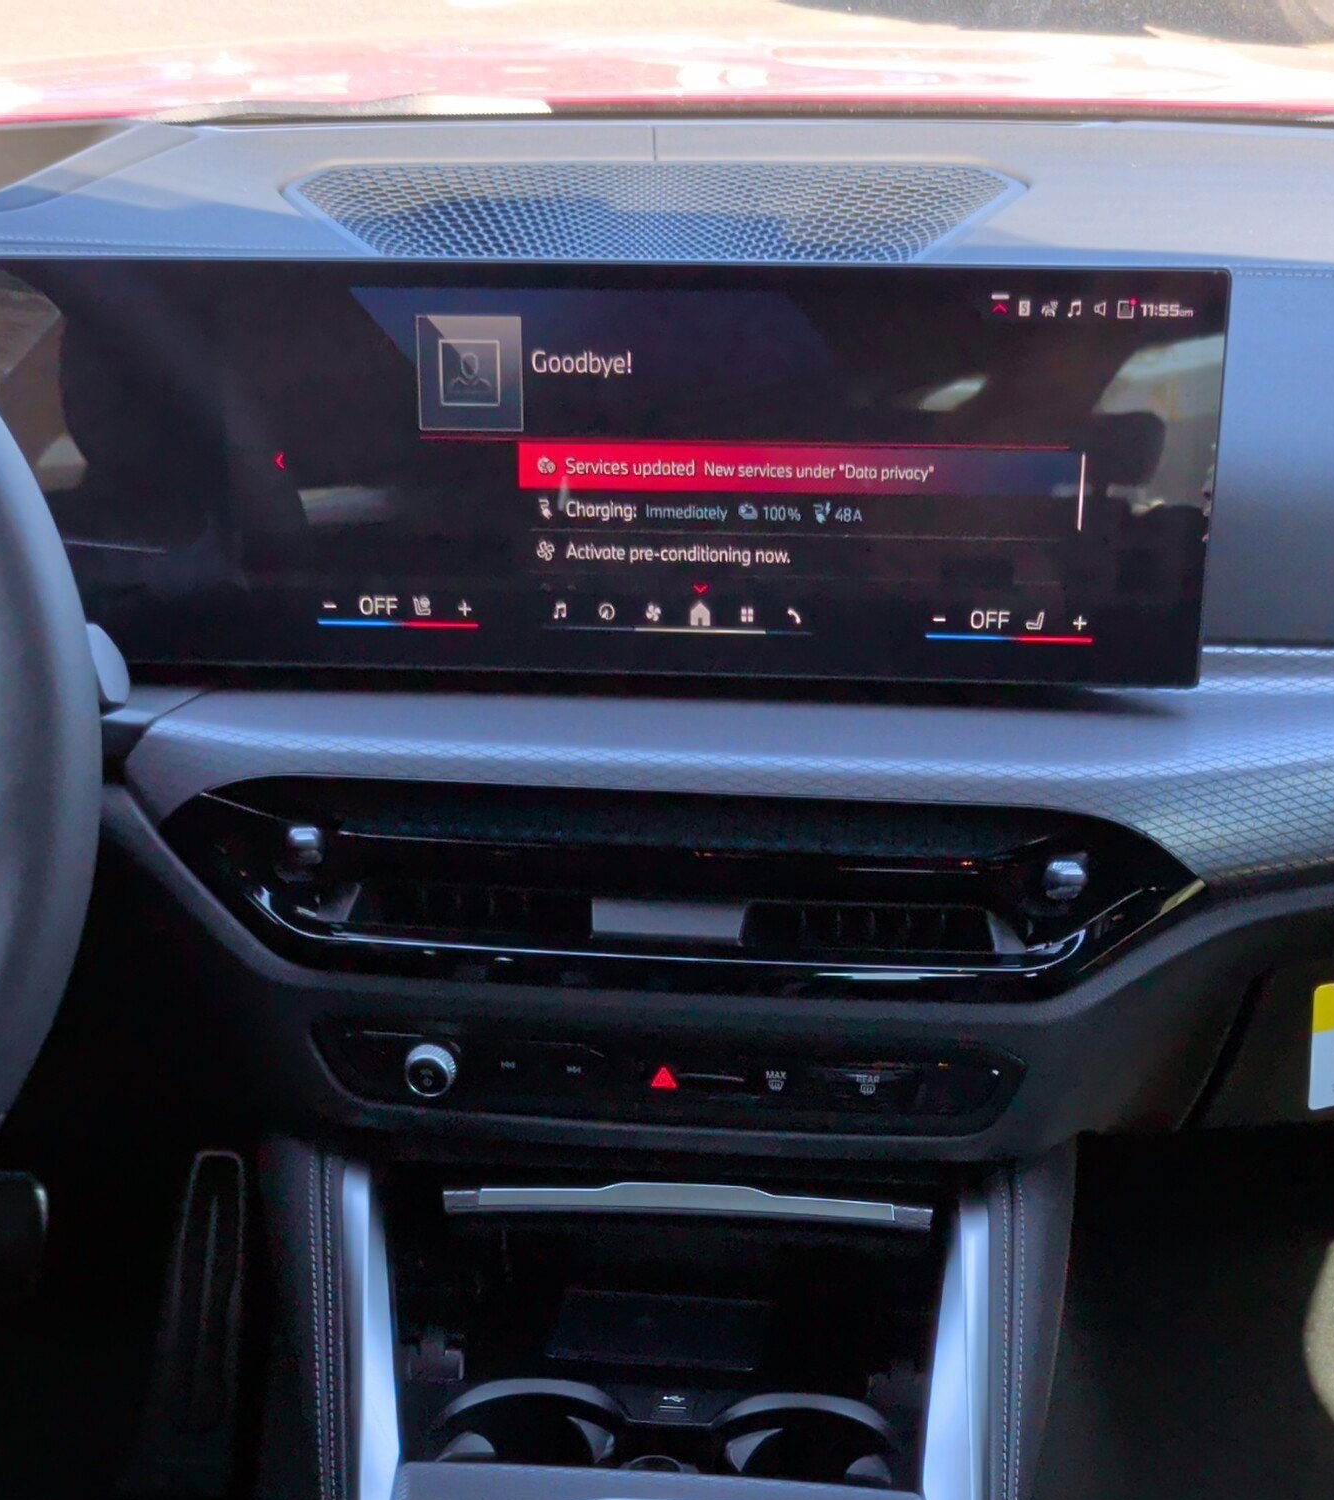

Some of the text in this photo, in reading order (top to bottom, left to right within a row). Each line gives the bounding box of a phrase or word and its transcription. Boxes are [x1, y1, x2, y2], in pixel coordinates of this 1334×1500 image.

[1140, 302, 1194, 318] 11:55am
[531, 350, 632, 378] Goodbye!
[565, 457, 935, 483] Services updated New services under "Data privacy"
[566, 499, 637, 522] Charging:
[646, 503, 728, 522] Immediately
[763, 505, 802, 522] 100%
[566, 541, 791, 567] Activate pre-conditioning now.
[358, 596, 398, 616] OFF
[970, 609, 1011, 630] OFF
[766, 1070, 787, 1080] MAX
